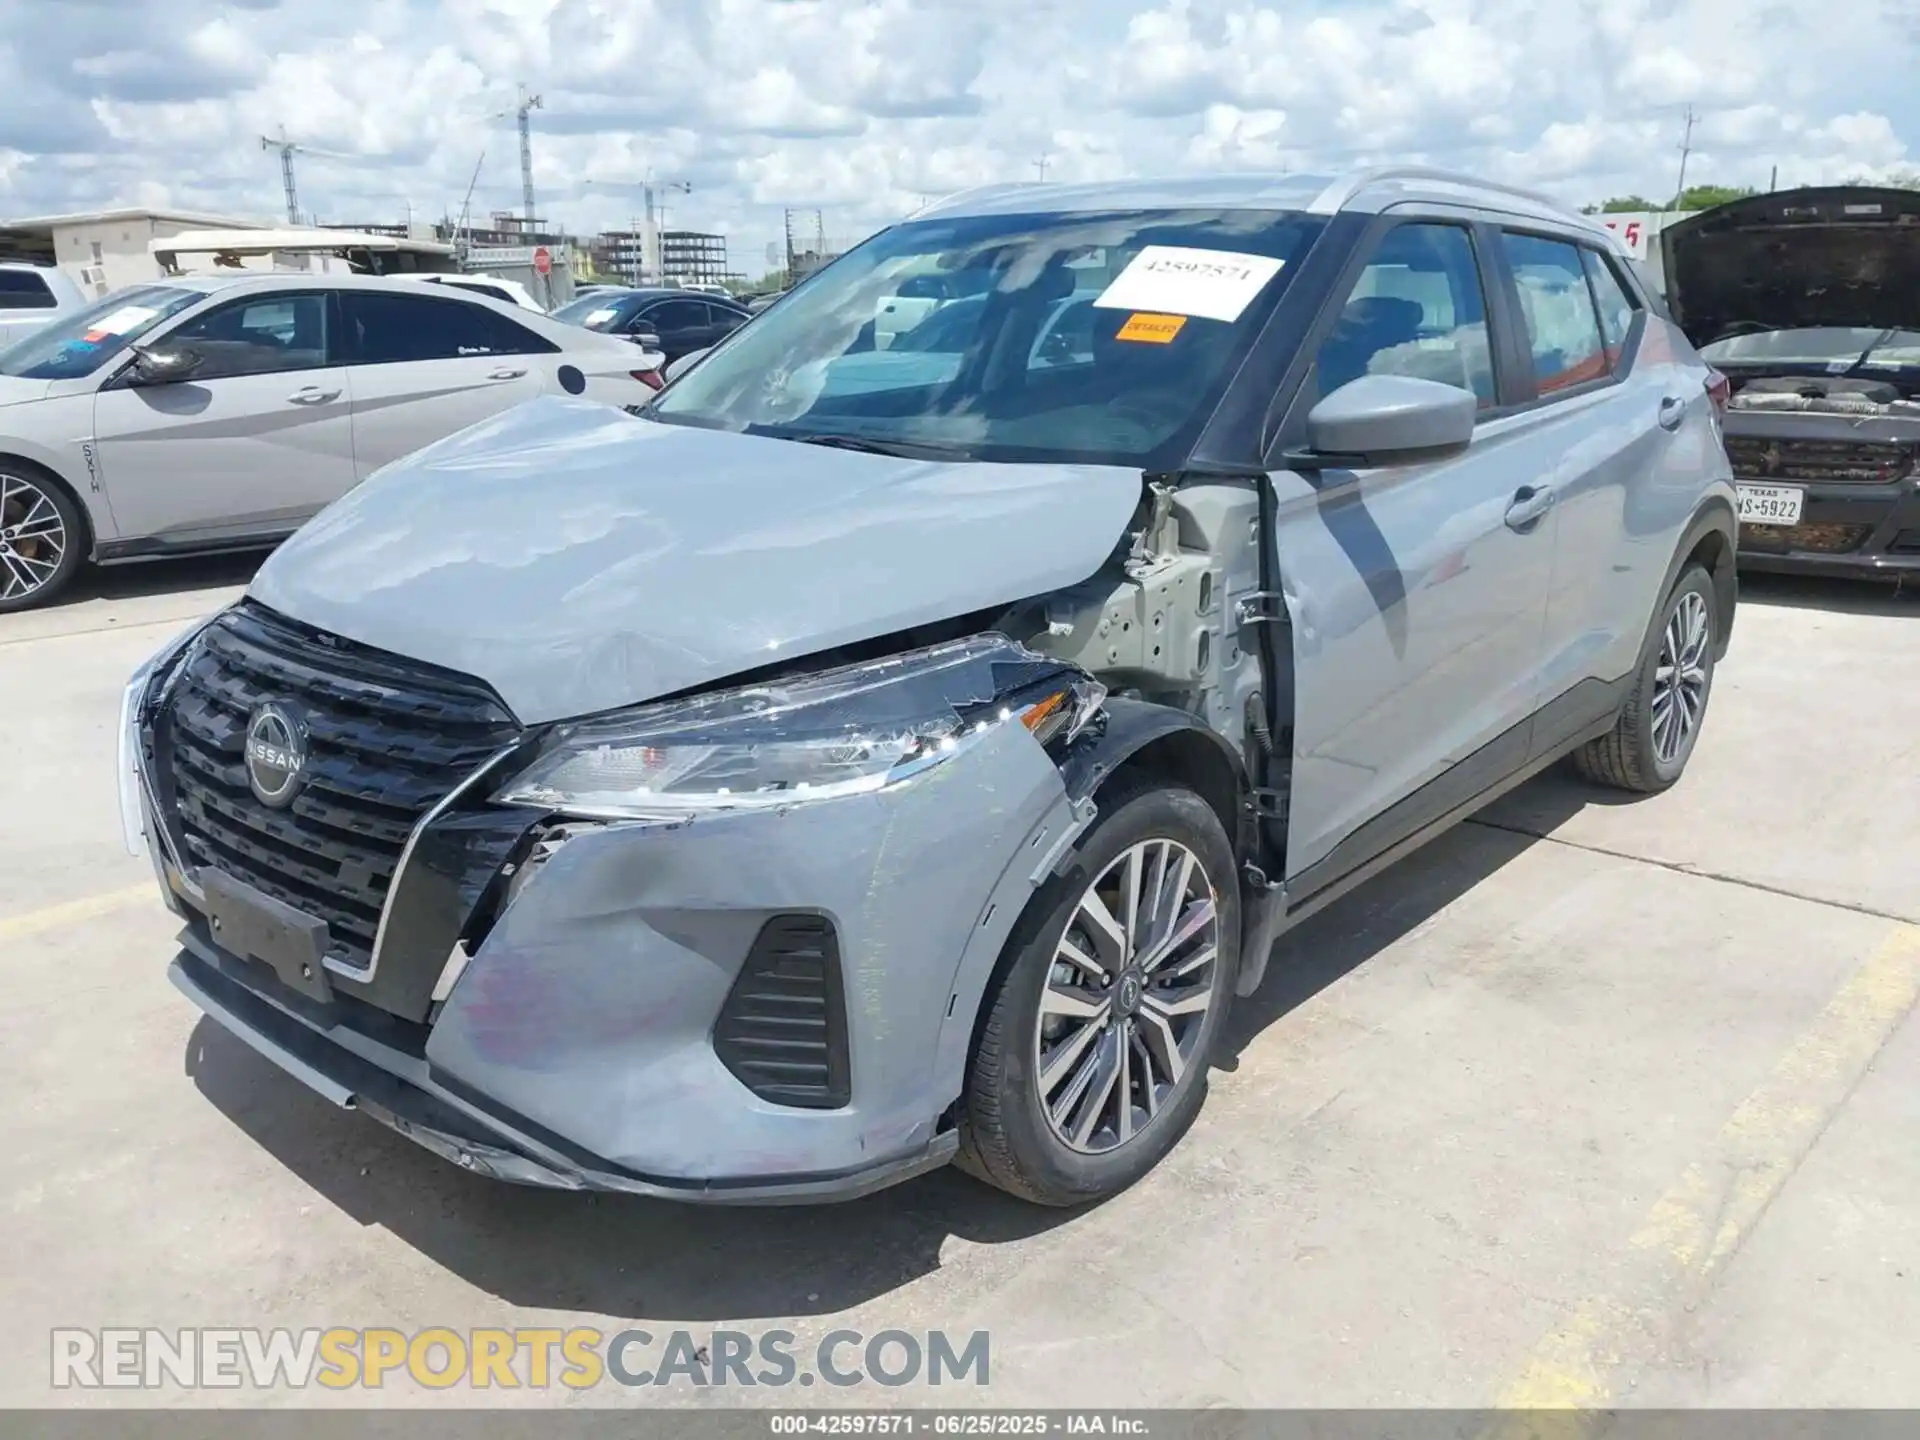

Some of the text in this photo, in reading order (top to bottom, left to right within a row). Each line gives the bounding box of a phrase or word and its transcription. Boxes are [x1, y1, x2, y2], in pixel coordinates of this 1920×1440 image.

[1143, 259, 1252, 281] 42597571
[1749, 488, 1779, 497] TEXAS
[248, 739, 301, 771] NISSAN
